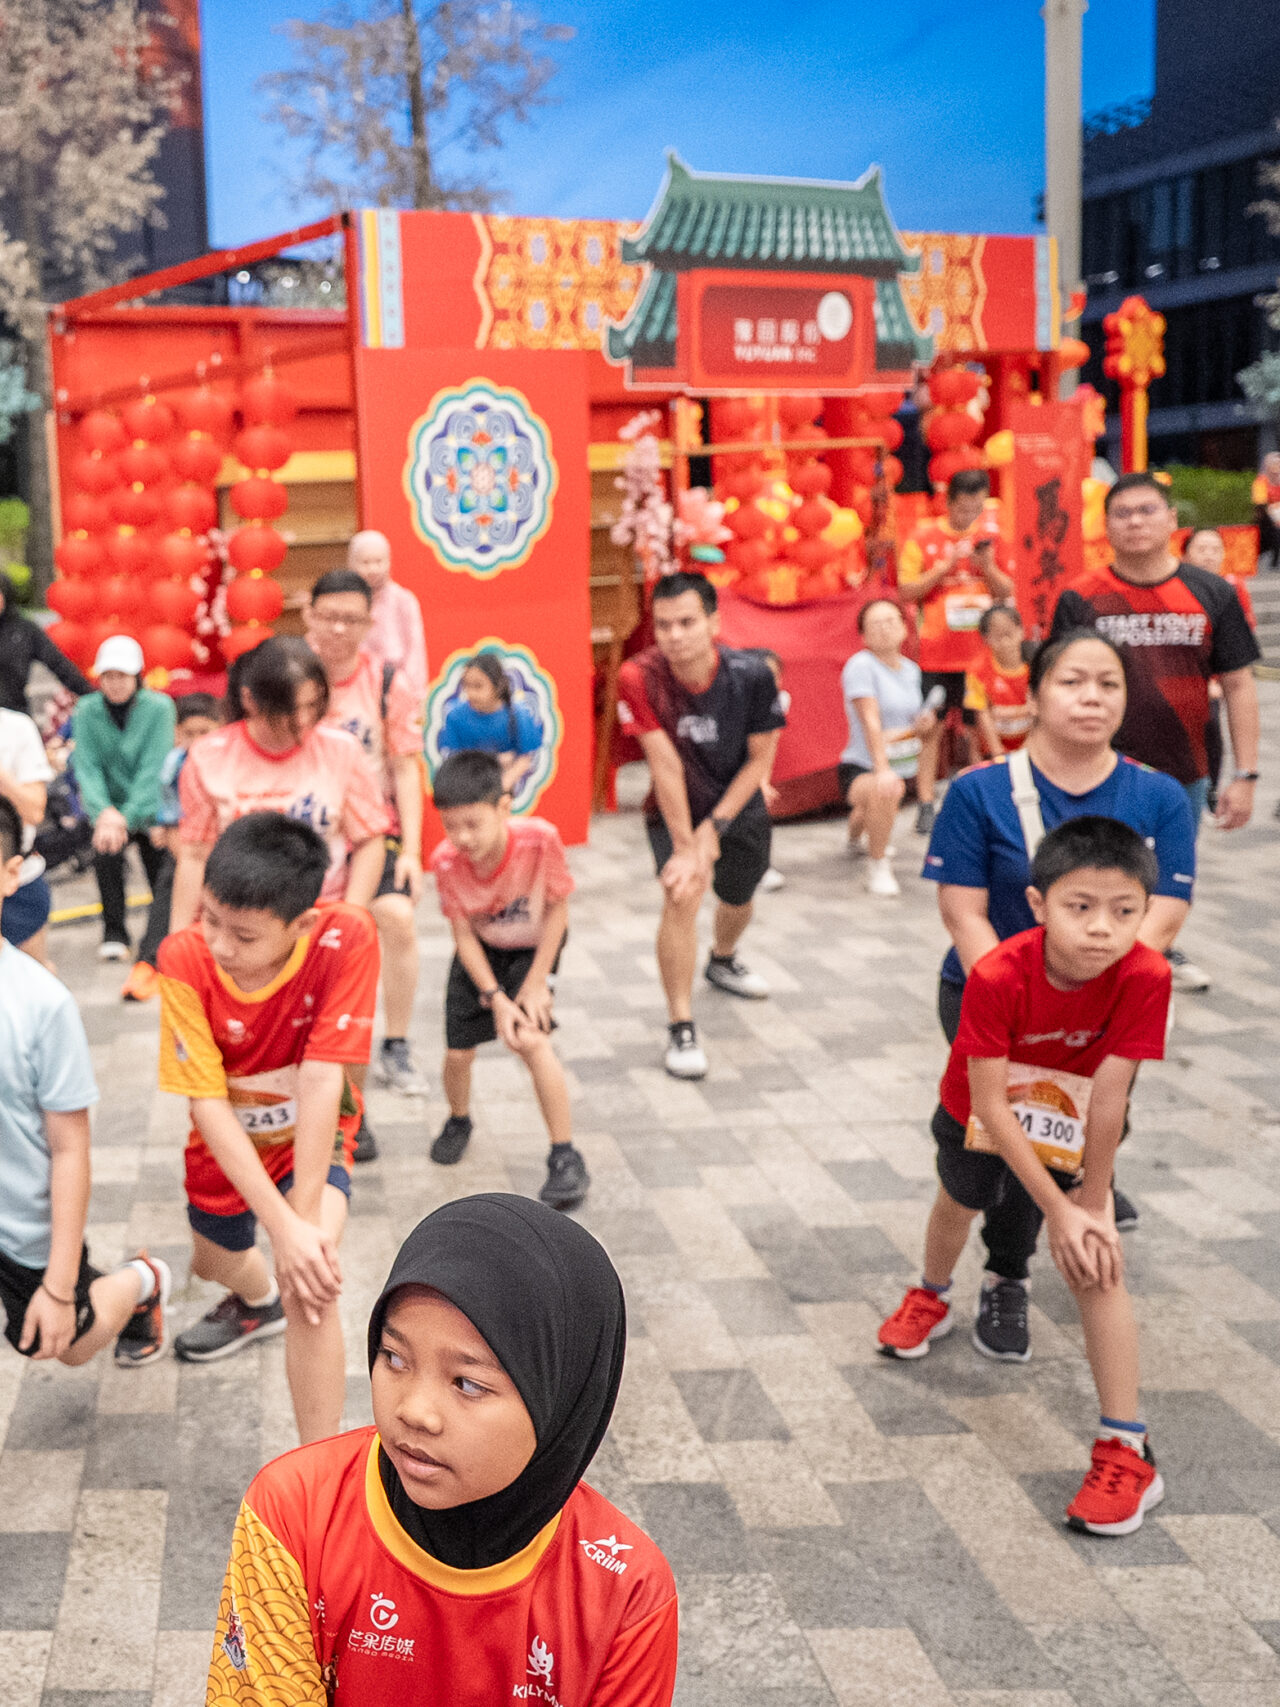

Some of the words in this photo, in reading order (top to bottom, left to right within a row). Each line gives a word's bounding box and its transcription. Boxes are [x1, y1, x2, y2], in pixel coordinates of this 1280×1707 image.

[244, 1108, 290, 1128] 243
[1040, 1117, 1075, 1143] 300
[348, 1628, 416, 1656] 芒果传媒
